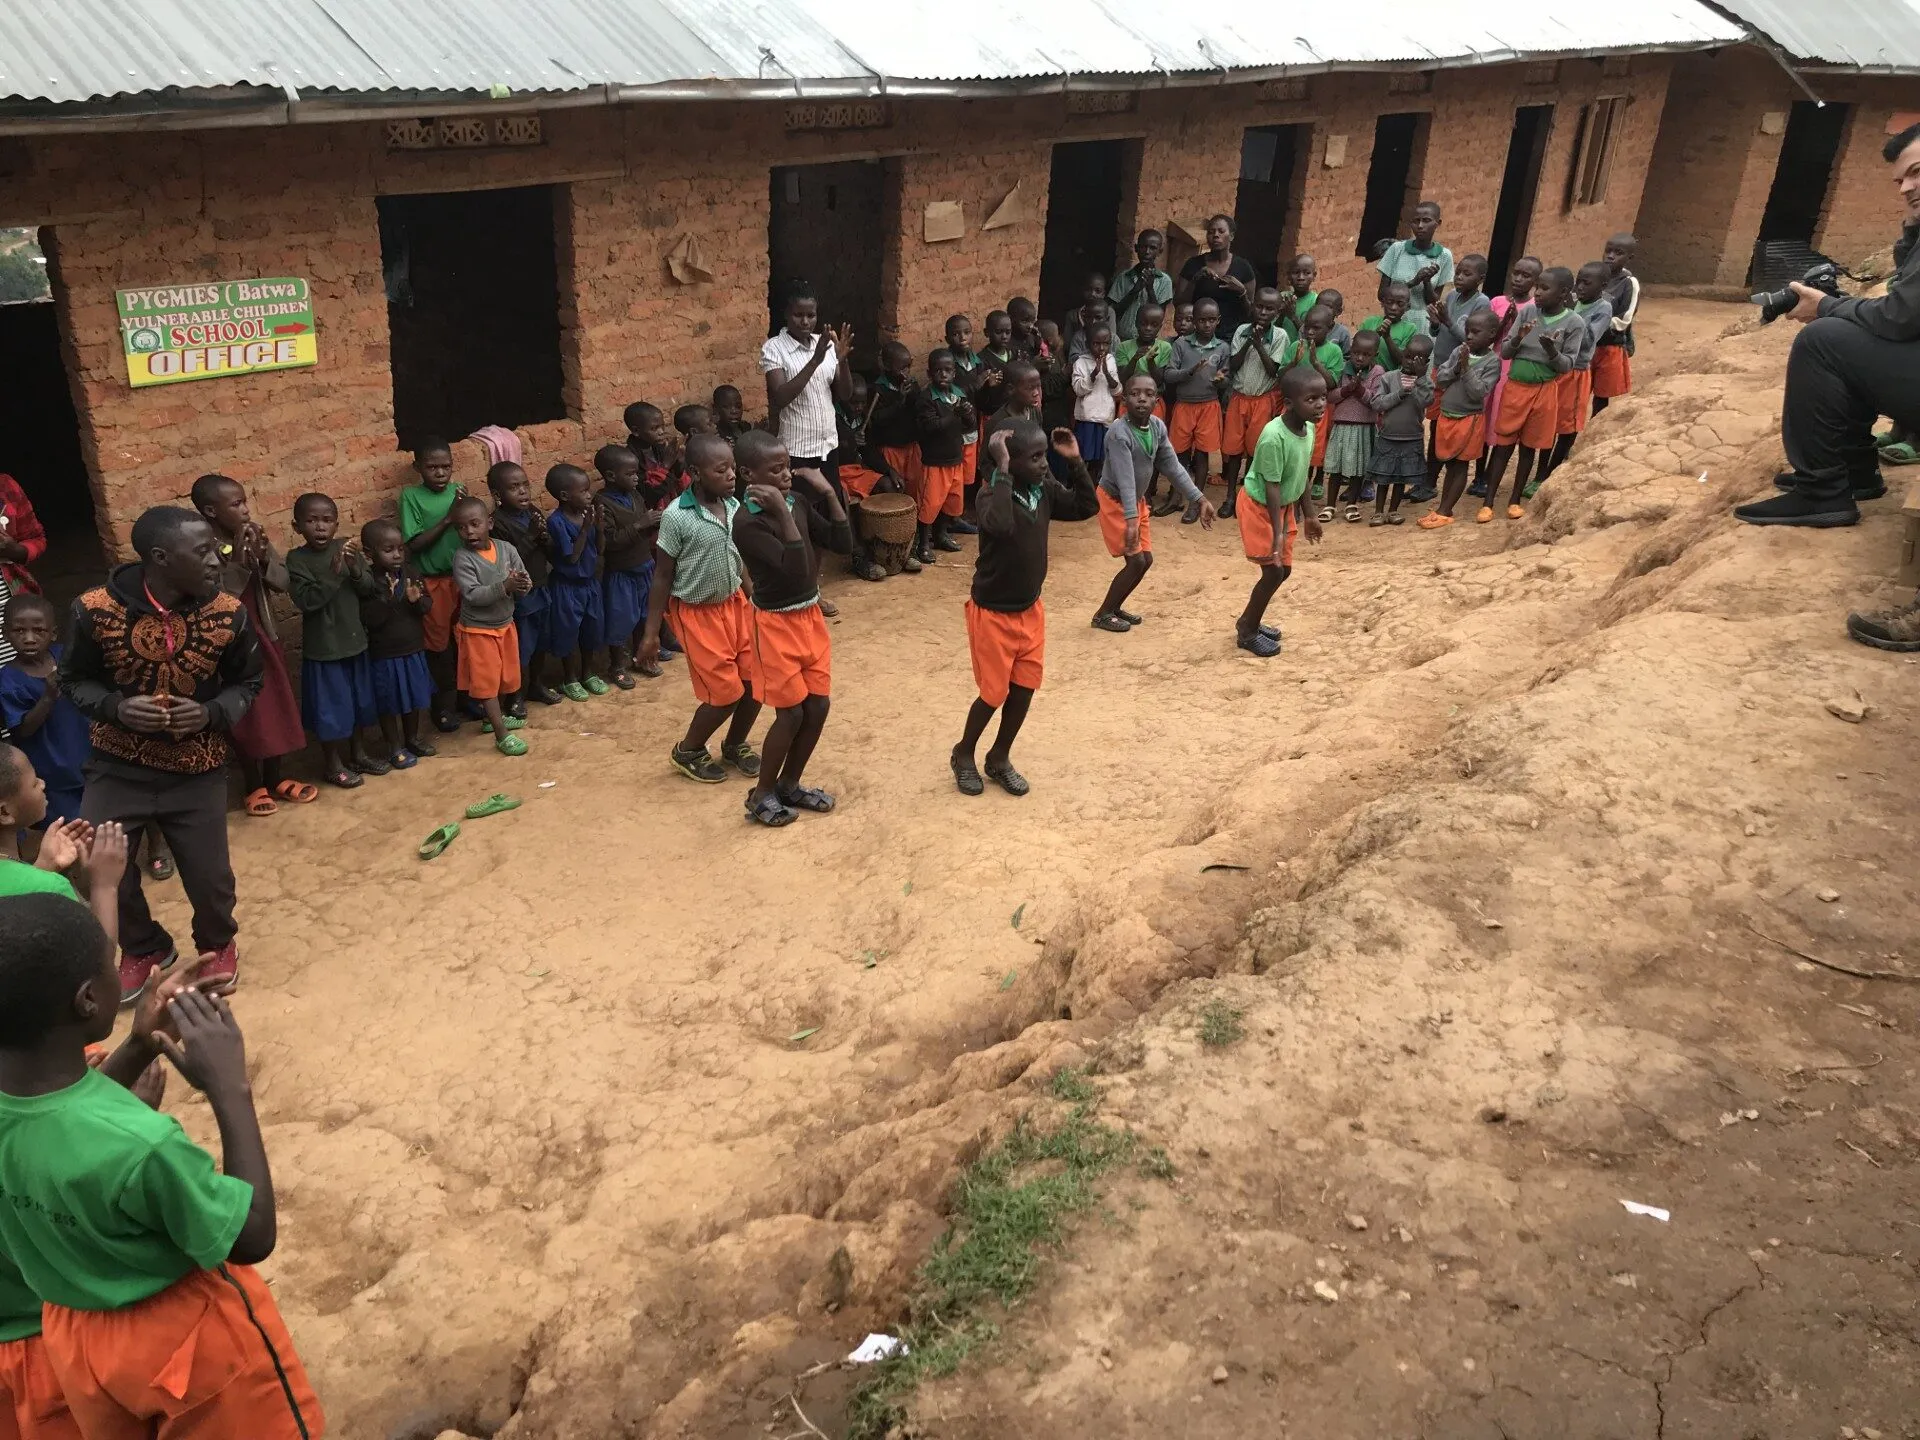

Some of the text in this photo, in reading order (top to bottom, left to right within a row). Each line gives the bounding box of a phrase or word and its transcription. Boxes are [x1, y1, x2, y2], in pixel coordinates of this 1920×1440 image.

[124, 286, 219, 311] PYGMIES
[122, 301, 308, 330] VULNERABLE CHILDREN
[171, 319, 271, 347] SCHOOL
[148, 339, 297, 376] OFFICE
